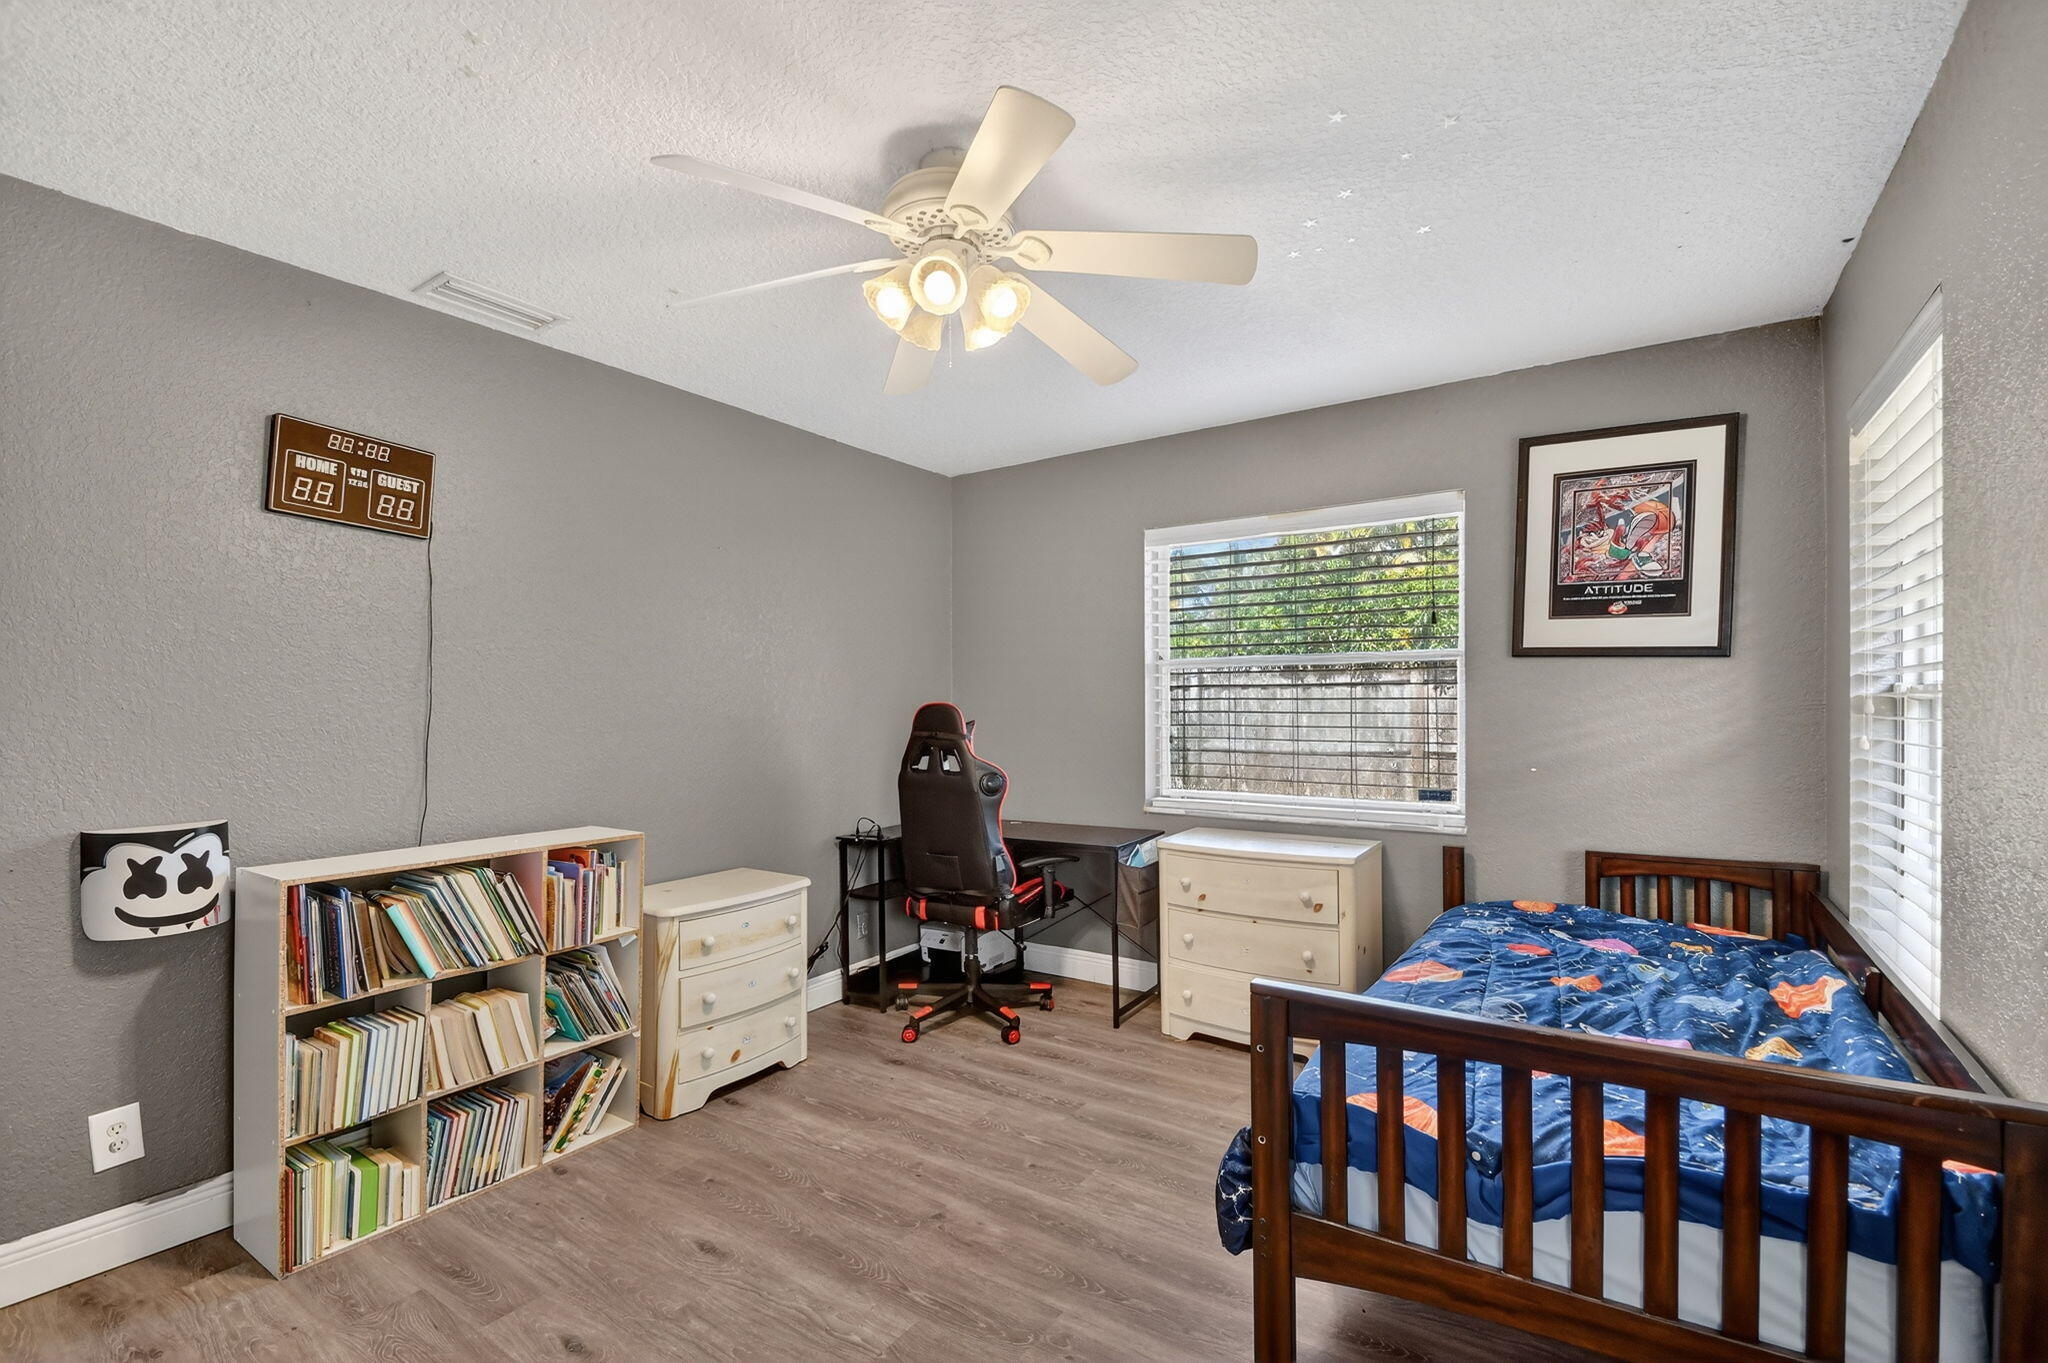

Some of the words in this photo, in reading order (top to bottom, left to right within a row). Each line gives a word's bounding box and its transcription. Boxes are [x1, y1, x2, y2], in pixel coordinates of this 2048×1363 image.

[295, 454, 338, 476] HOME
[377, 473, 420, 494] GUEST
[1584, 583, 1654, 595] ATTITUDE
